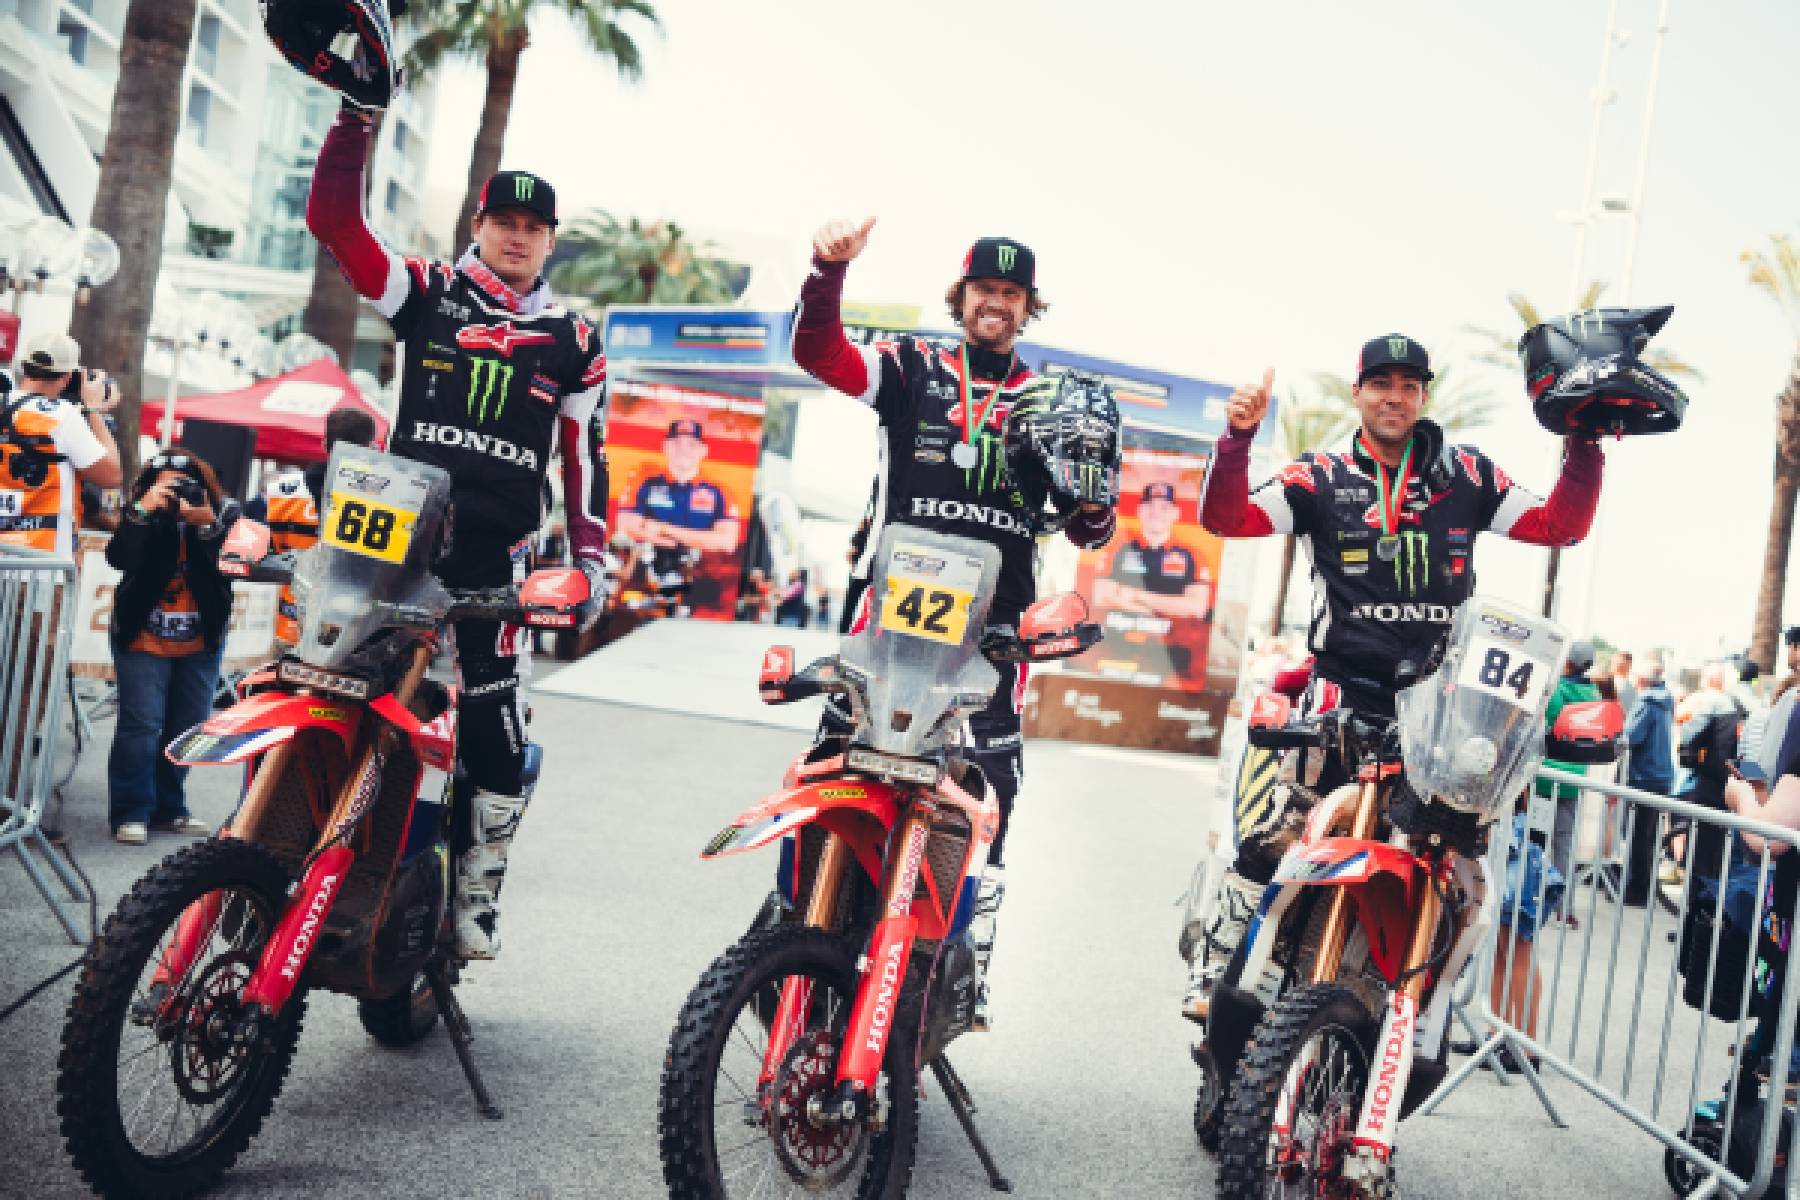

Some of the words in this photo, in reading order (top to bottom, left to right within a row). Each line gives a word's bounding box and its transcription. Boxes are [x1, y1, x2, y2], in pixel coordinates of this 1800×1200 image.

[412, 422, 537, 471] HONDA
[336, 501, 396, 551] 68
[896, 587, 954, 633] 42
[1479, 647, 1534, 699] 84
[281, 873, 337, 980] HONDA
[866, 942, 904, 1053] HONDA
[1366, 1016, 1409, 1131] HONDA
